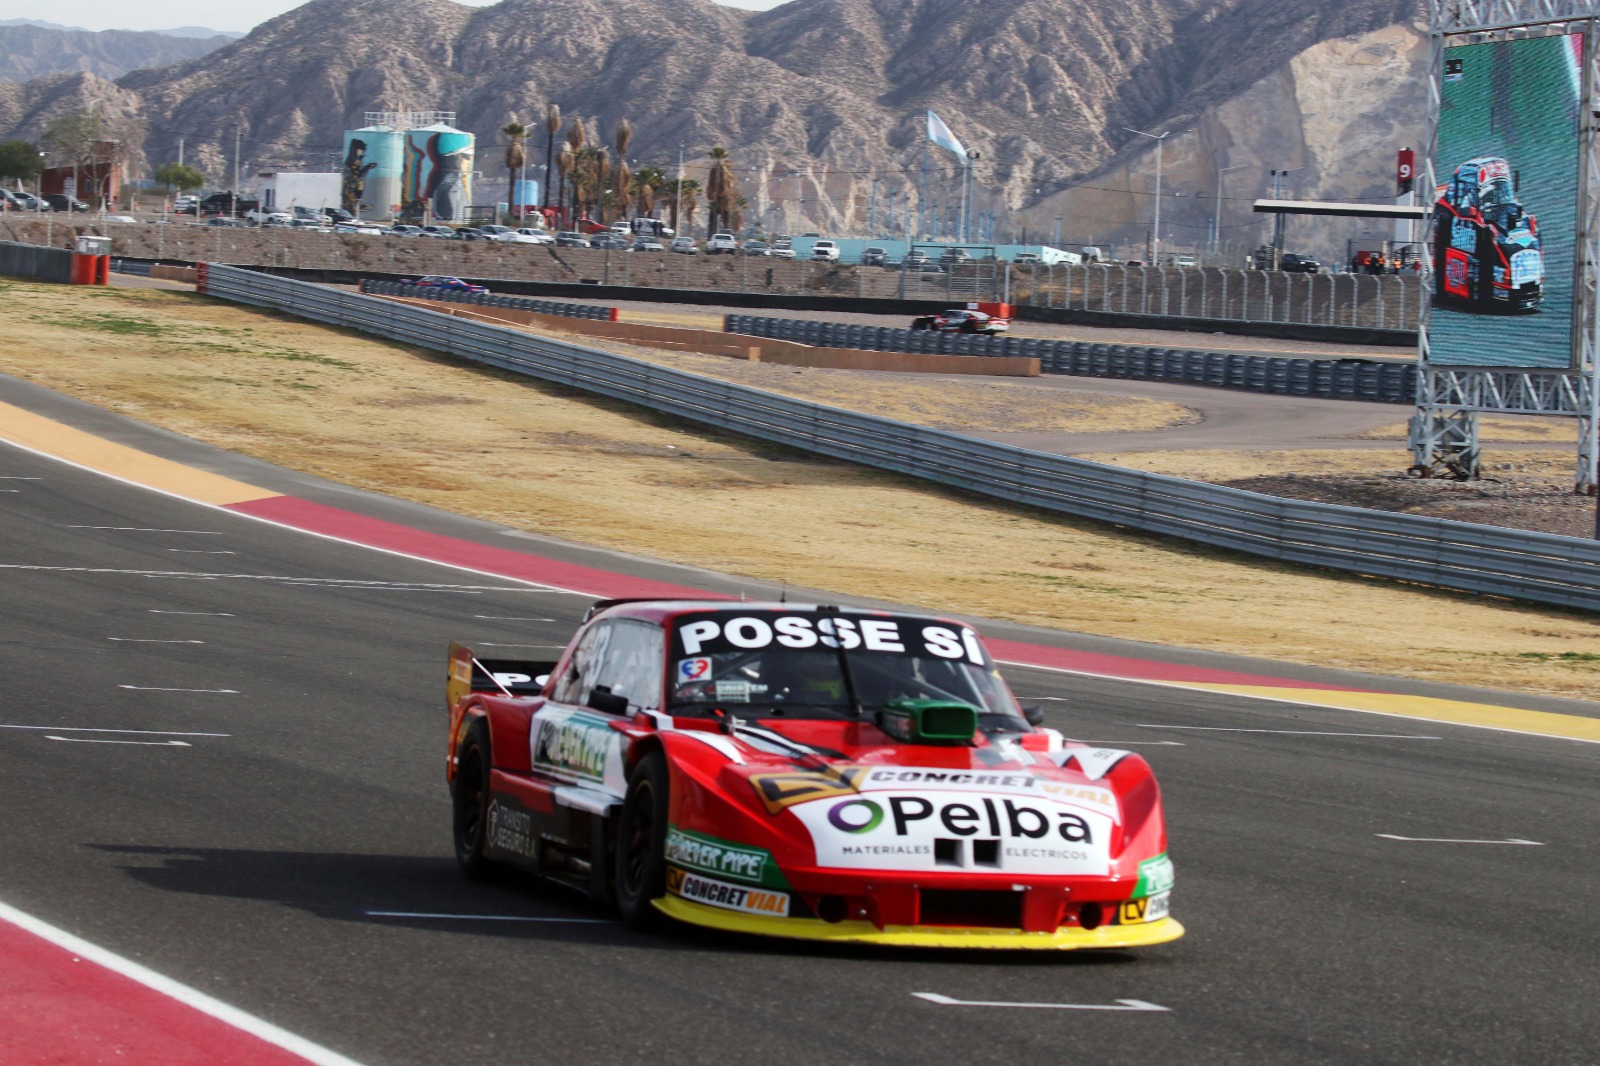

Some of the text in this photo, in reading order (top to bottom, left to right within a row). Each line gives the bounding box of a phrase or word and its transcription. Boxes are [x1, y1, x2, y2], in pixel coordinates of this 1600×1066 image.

[1400, 163, 1411, 178] 9
[679, 616, 905, 655] POSSE
[888, 796, 1093, 844] Pelba
[721, 850, 763, 876] PIPE
[842, 845, 1088, 861] MATERIALES ELECTRICOS
